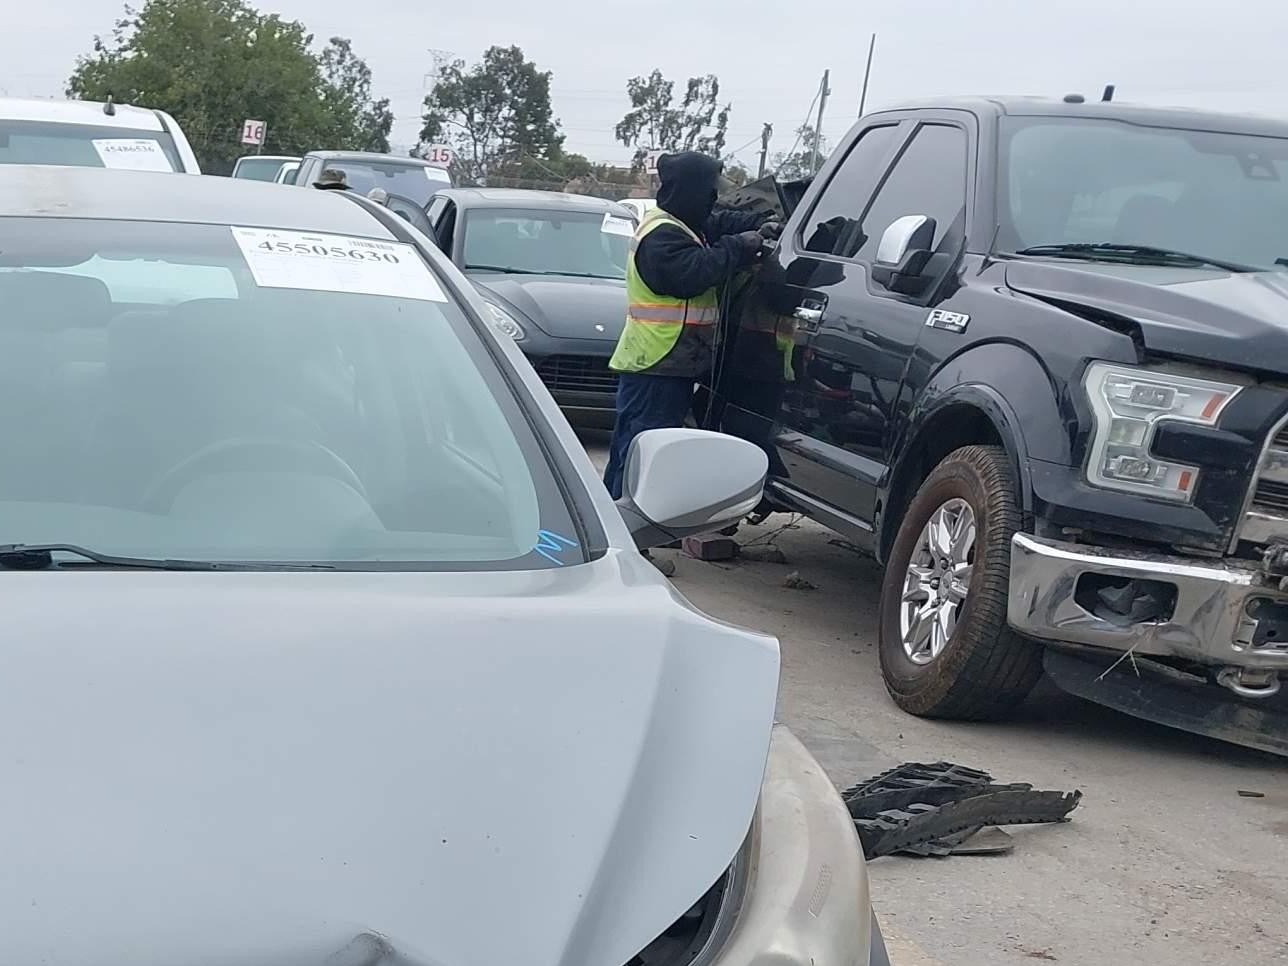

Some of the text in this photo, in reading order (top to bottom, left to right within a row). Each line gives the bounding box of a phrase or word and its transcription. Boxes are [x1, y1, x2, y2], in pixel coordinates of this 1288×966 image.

[244, 125, 264, 140] 16
[432, 148, 450, 163] 15
[258, 240, 400, 264] 45505630
